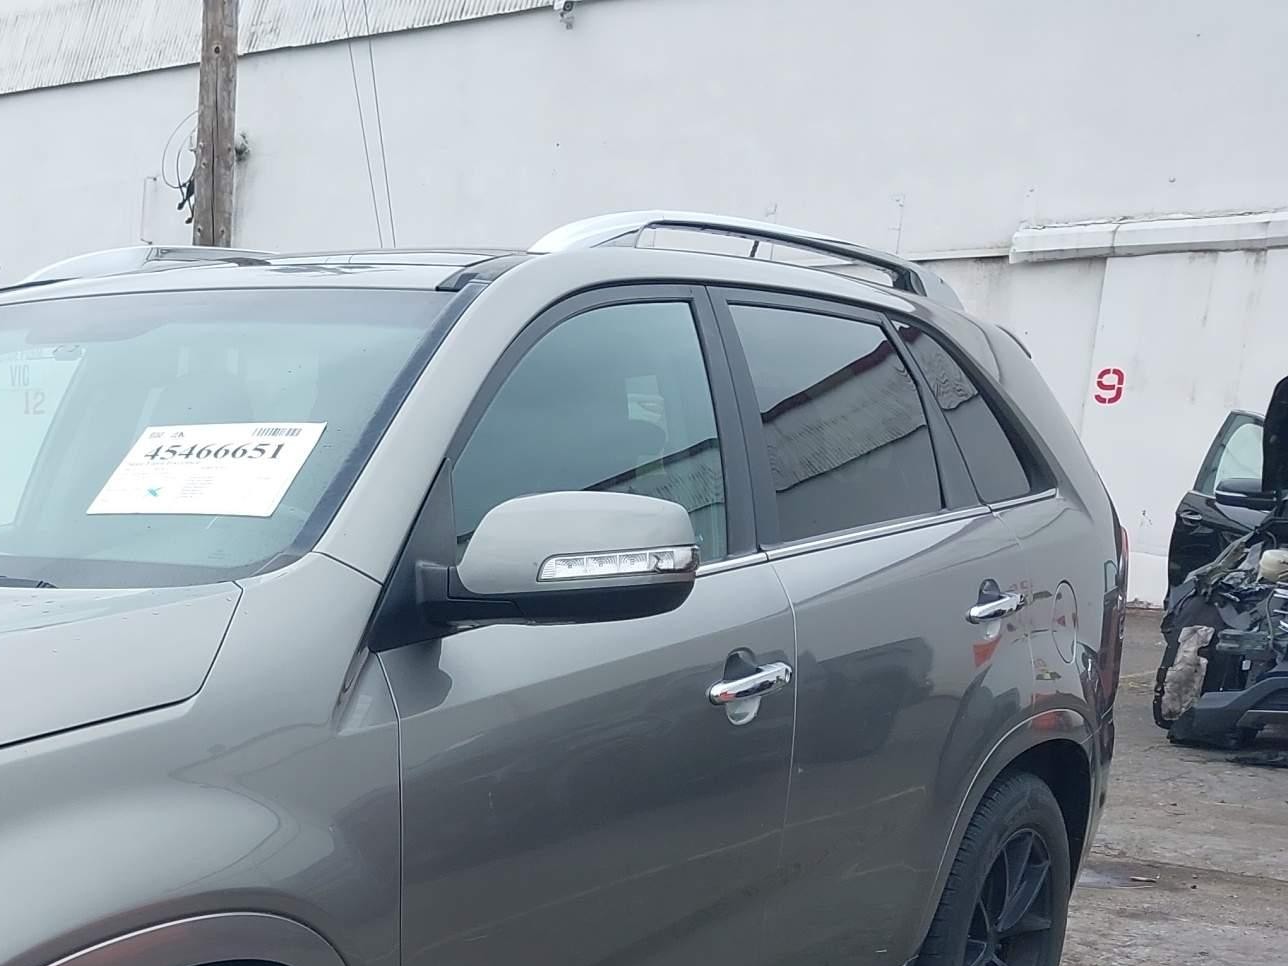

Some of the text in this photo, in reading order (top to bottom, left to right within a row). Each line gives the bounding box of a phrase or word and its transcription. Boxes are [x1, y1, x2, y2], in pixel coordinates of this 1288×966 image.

[9, 364, 30, 387] VIC
[1094, 368, 1124, 404] 9
[24, 390, 46, 415] 12
[144, 443, 285, 460] 45466651
